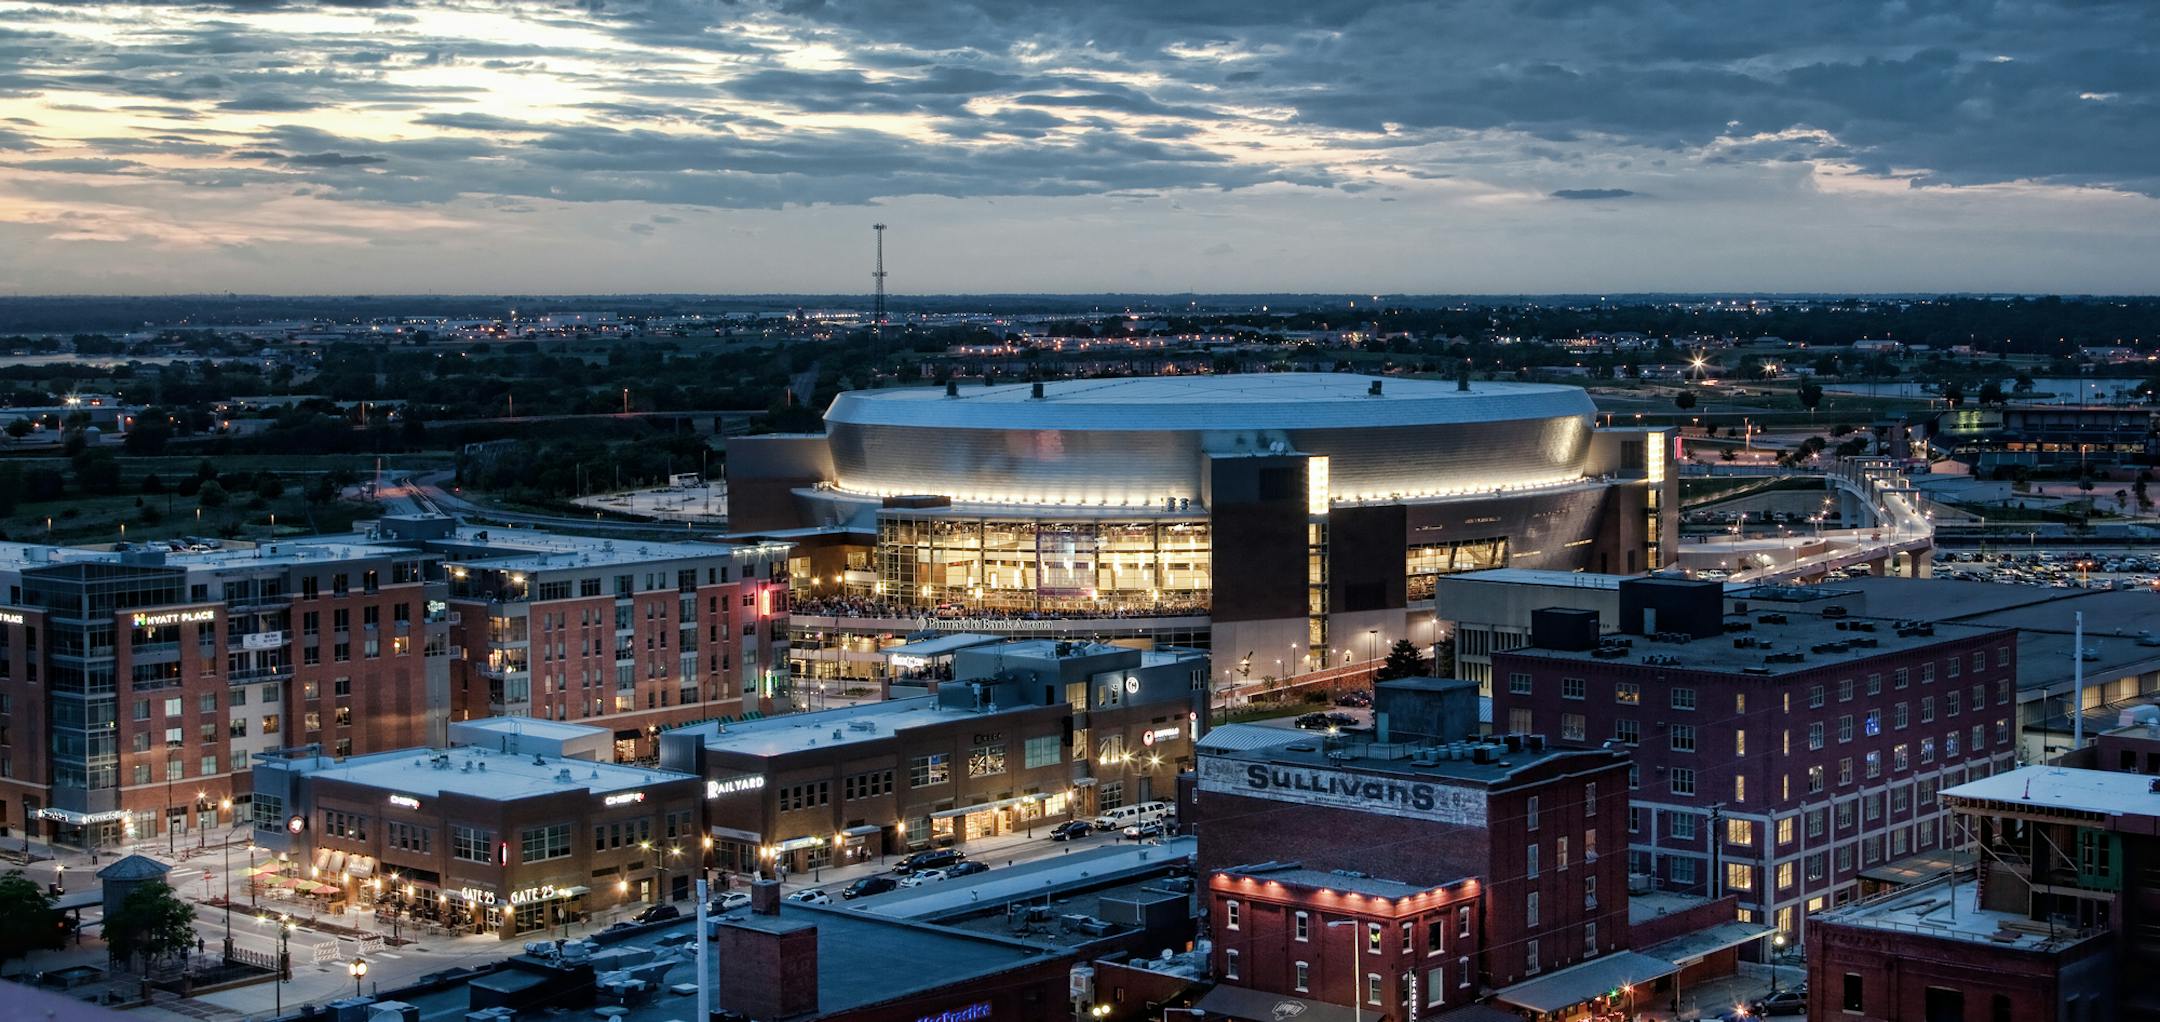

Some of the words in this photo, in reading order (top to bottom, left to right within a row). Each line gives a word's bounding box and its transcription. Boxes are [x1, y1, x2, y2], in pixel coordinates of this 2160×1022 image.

[147, 613, 179, 625] HYATT
[181, 611, 214, 622] PLACE
[928, 617, 981, 630] Pinnacle
[982, 617, 1012, 630] Bank
[1012, 618, 1053, 630] Arena
[707, 776, 765, 799] RAILYARD
[461, 887, 483, 903] GATE
[484, 891, 495, 905] 25
[510, 887, 539, 904] GATE
[541, 884, 554, 899] 25
